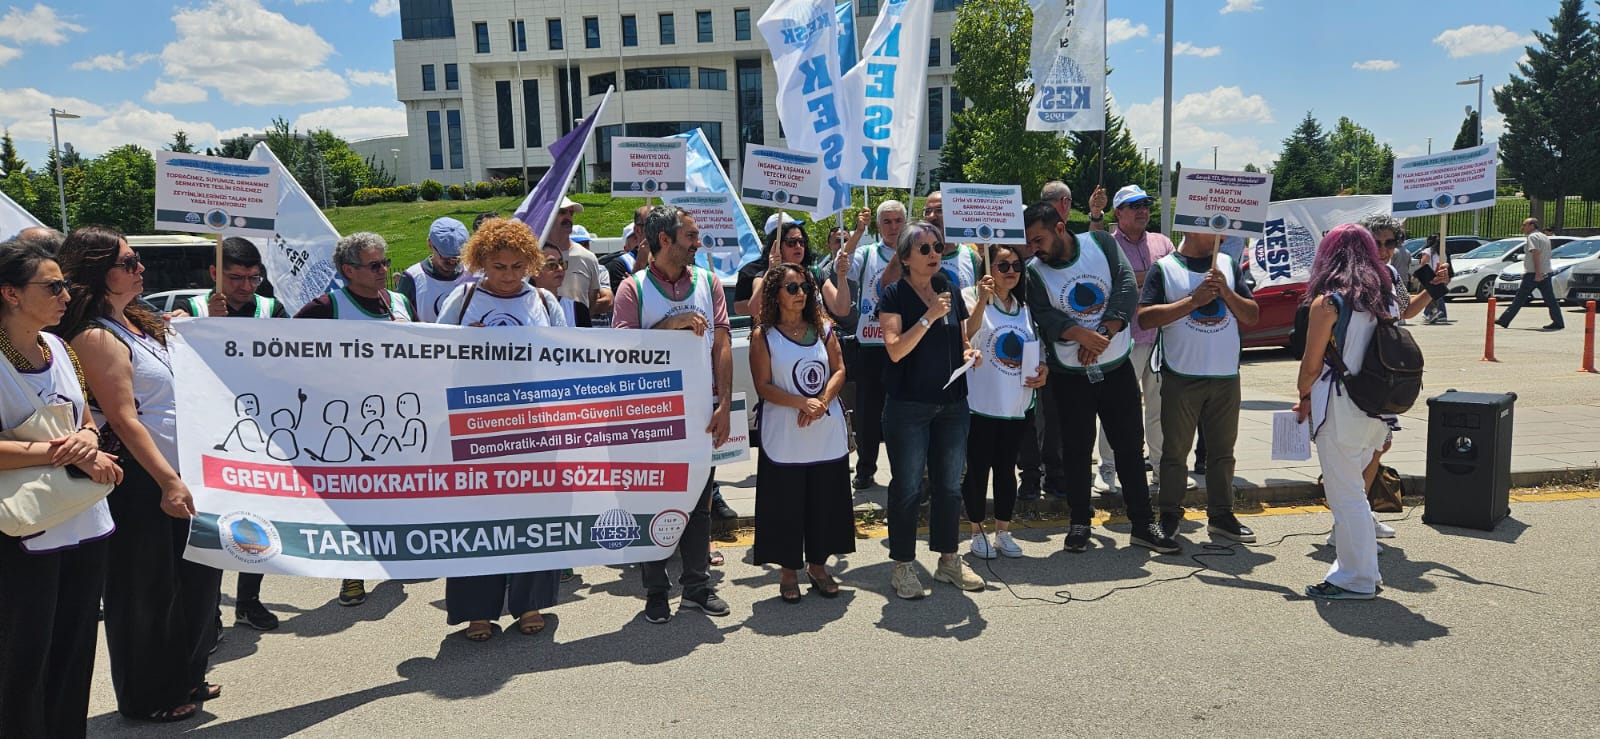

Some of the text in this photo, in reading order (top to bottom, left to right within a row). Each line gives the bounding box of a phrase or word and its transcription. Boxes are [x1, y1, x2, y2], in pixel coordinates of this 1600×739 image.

[757, 161, 811, 175] İNSANCA YAŞAMAYA
[763, 170, 805, 181] YETECEK ÜCRET
[175, 180, 210, 189] SERMAYEYE
[211, 183, 231, 191] TESLİM
[1214, 188, 1242, 196] MART'IN
[228, 194, 247, 202] TALAN
[1188, 194, 1209, 202] RESMİ
[1204, 203, 1241, 213] İSTİYORUZ!
[1265, 218, 1292, 281] KESK
[224, 337, 671, 366] 8. DÖNEM TİS TALEPLERİMİZİ AÇIKLIYORUZ!
[463, 376, 671, 405] İnsanca Yaşamaya Yetecek Bir Ücret!
[466, 401, 673, 430] Güvenceli İstihdam-Güvenli Gelecek!
[469, 424, 673, 455] Demokratik-Adil Bir Çalışma Yaşamı!
[221, 464, 665, 496] GREVLİ, DEMOKRATİK BİR TOPLU SÖZLEŞME!
[299, 520, 582, 555] TARIM ORKAM-SEN
[591, 526, 640, 541] KESK
